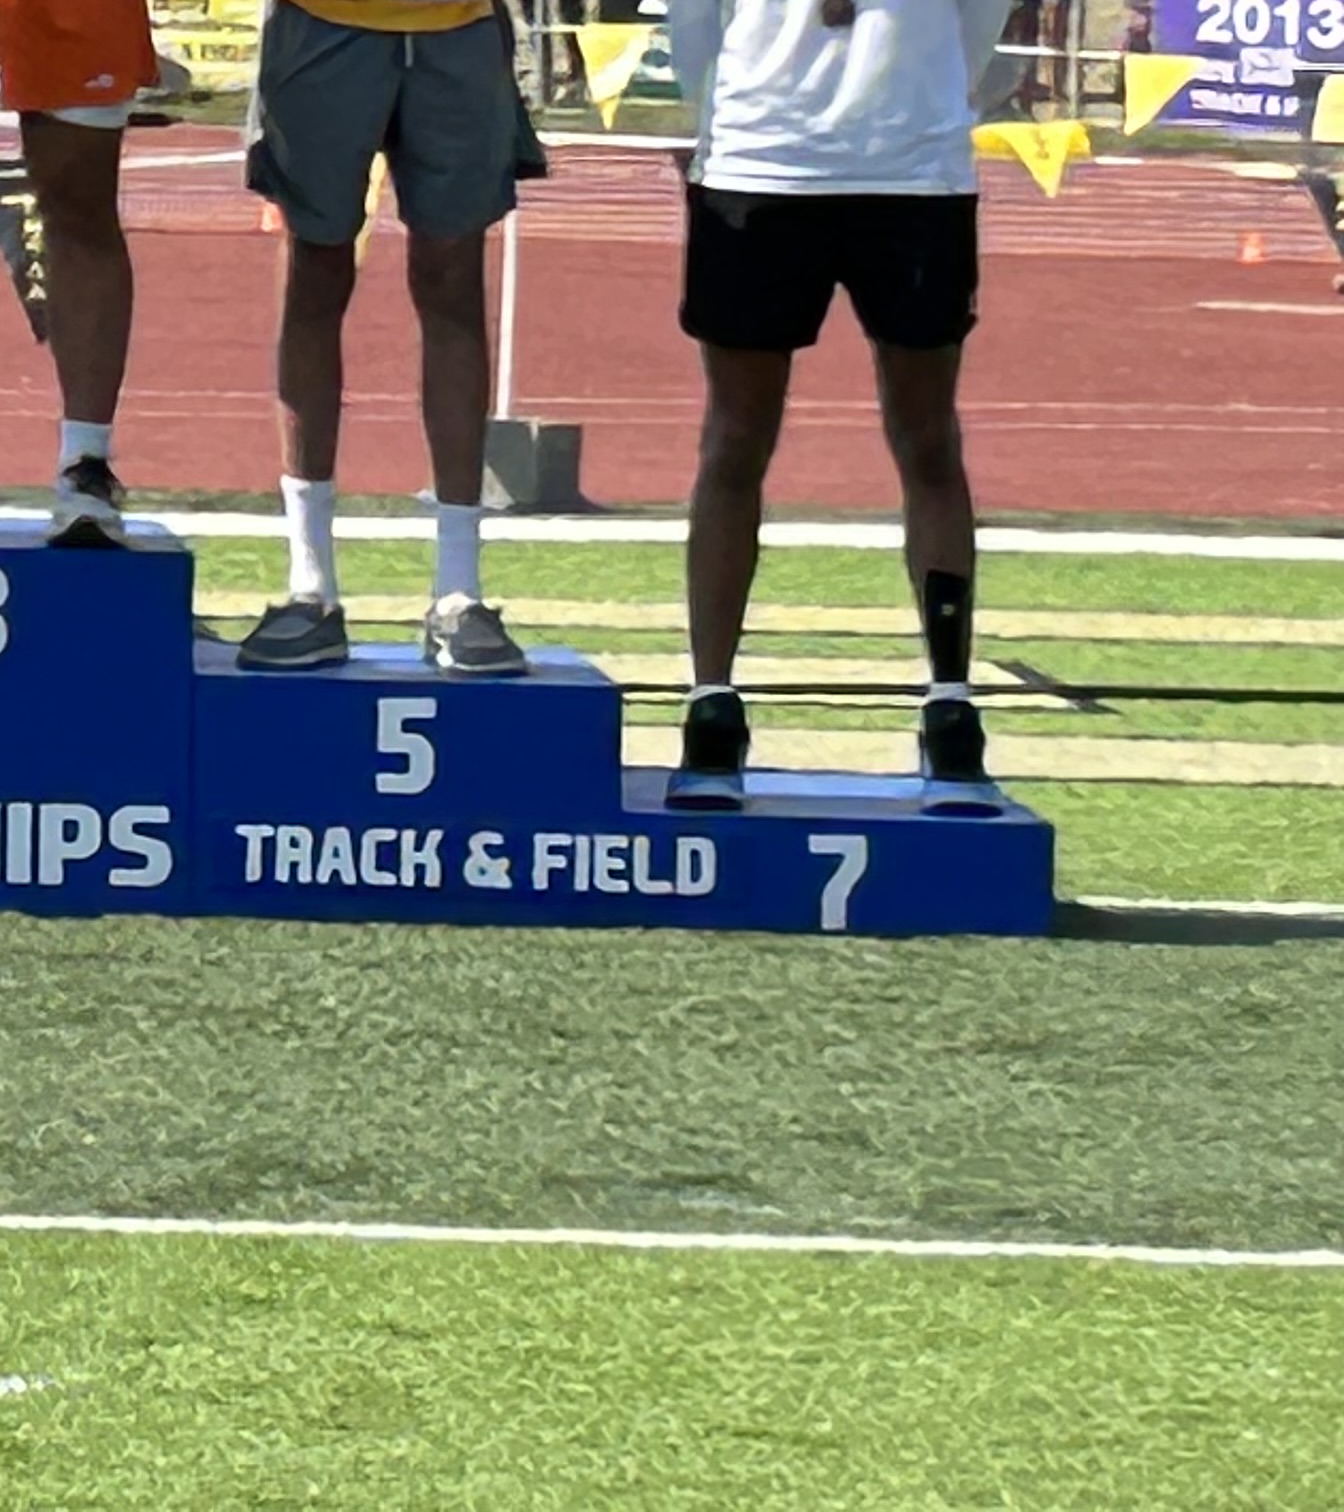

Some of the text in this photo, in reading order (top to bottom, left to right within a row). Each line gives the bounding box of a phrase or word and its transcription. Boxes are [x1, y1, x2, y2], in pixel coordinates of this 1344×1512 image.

[375, 697, 437, 795] 5
[235, 824, 716, 897] TRACK & FIELD
[806, 834, 869, 931] 7
